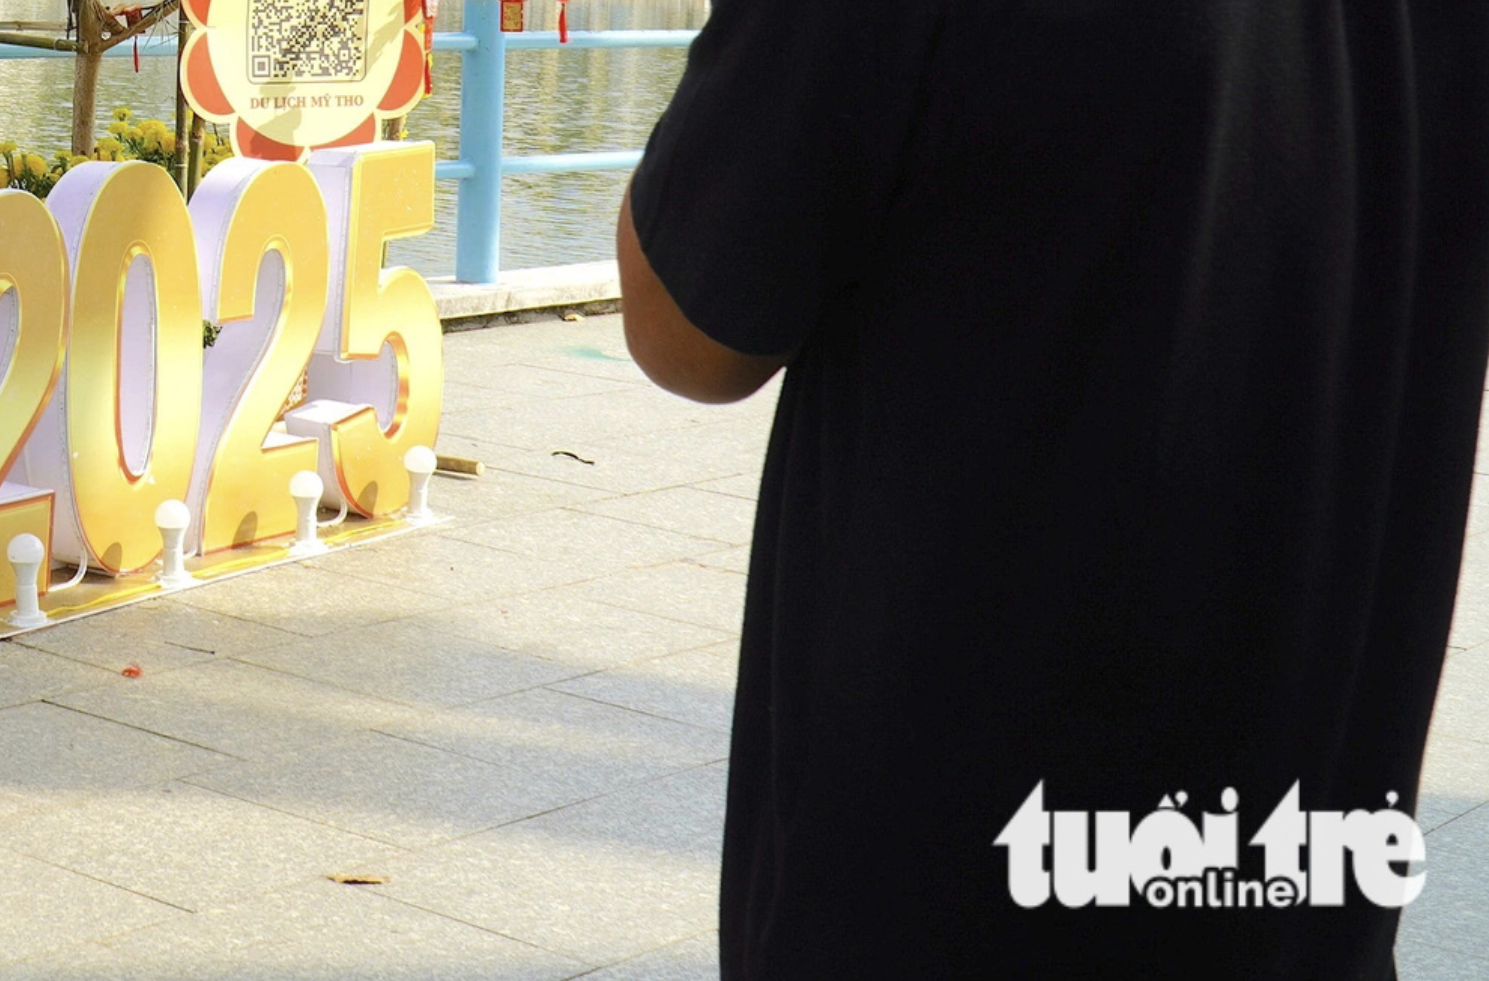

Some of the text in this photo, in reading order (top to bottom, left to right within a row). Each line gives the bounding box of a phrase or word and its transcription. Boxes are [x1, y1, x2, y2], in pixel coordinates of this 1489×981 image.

[250, 93, 364, 112] DU LỊCH MỸ THO
